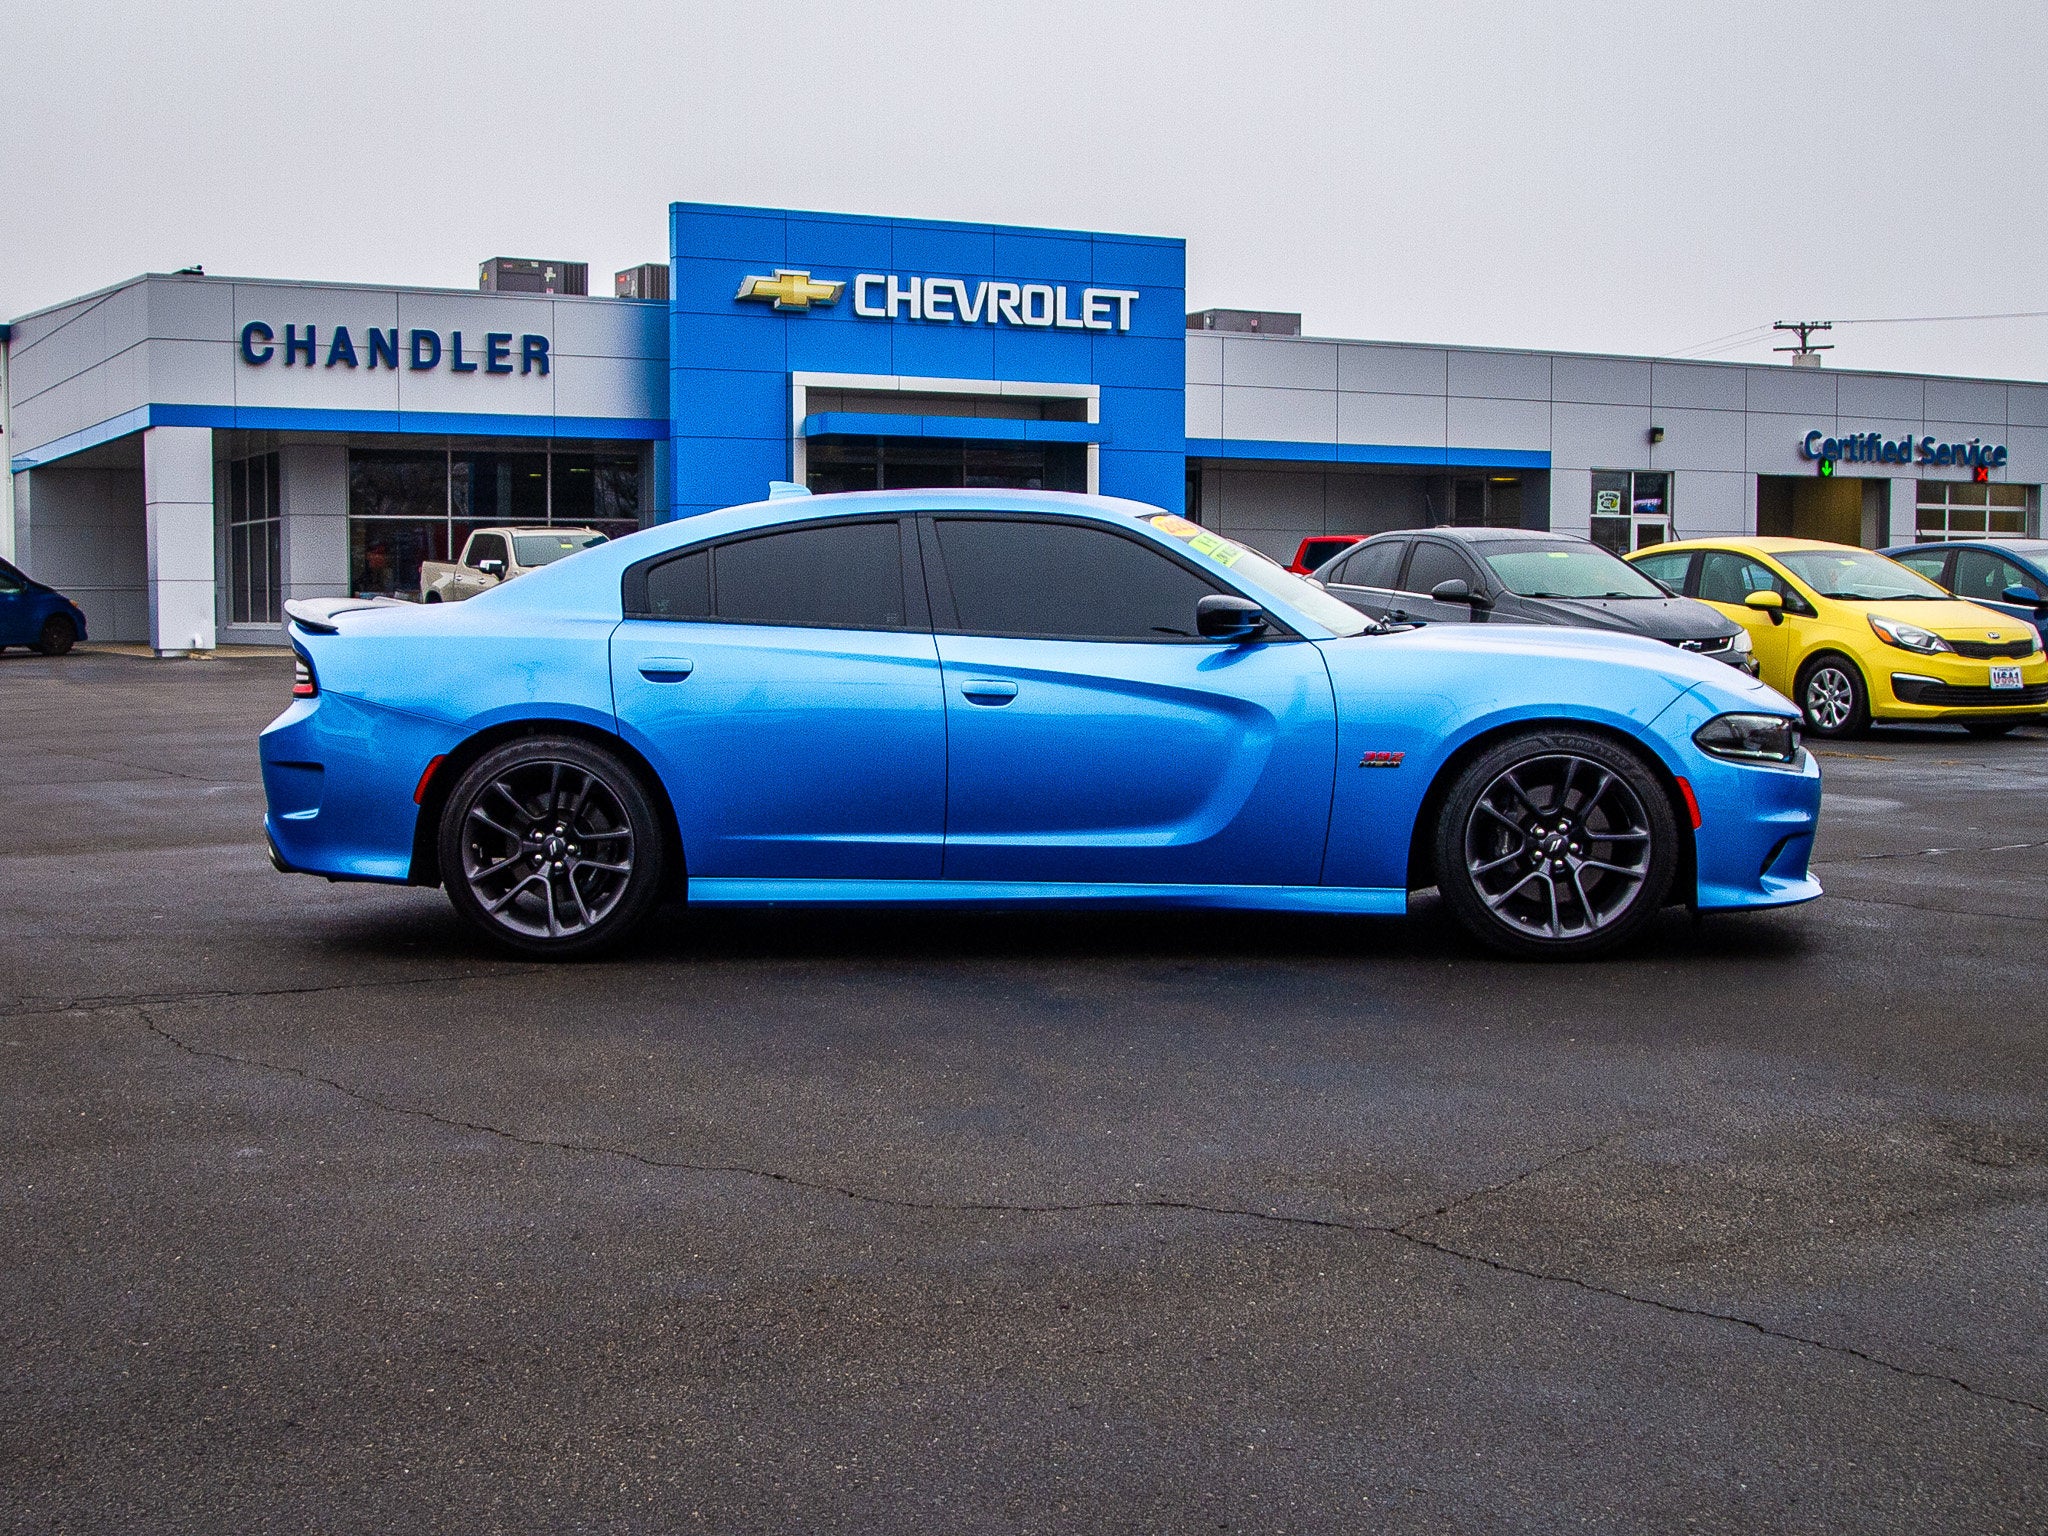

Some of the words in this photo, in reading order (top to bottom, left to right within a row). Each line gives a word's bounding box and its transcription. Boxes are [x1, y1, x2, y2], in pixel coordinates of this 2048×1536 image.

[853, 273, 1140, 331] CHEVROLET
[241, 320, 550, 375] CHANDLER
[1803, 430, 1913, 463] Certified
[1919, 436, 2008, 467] Service
